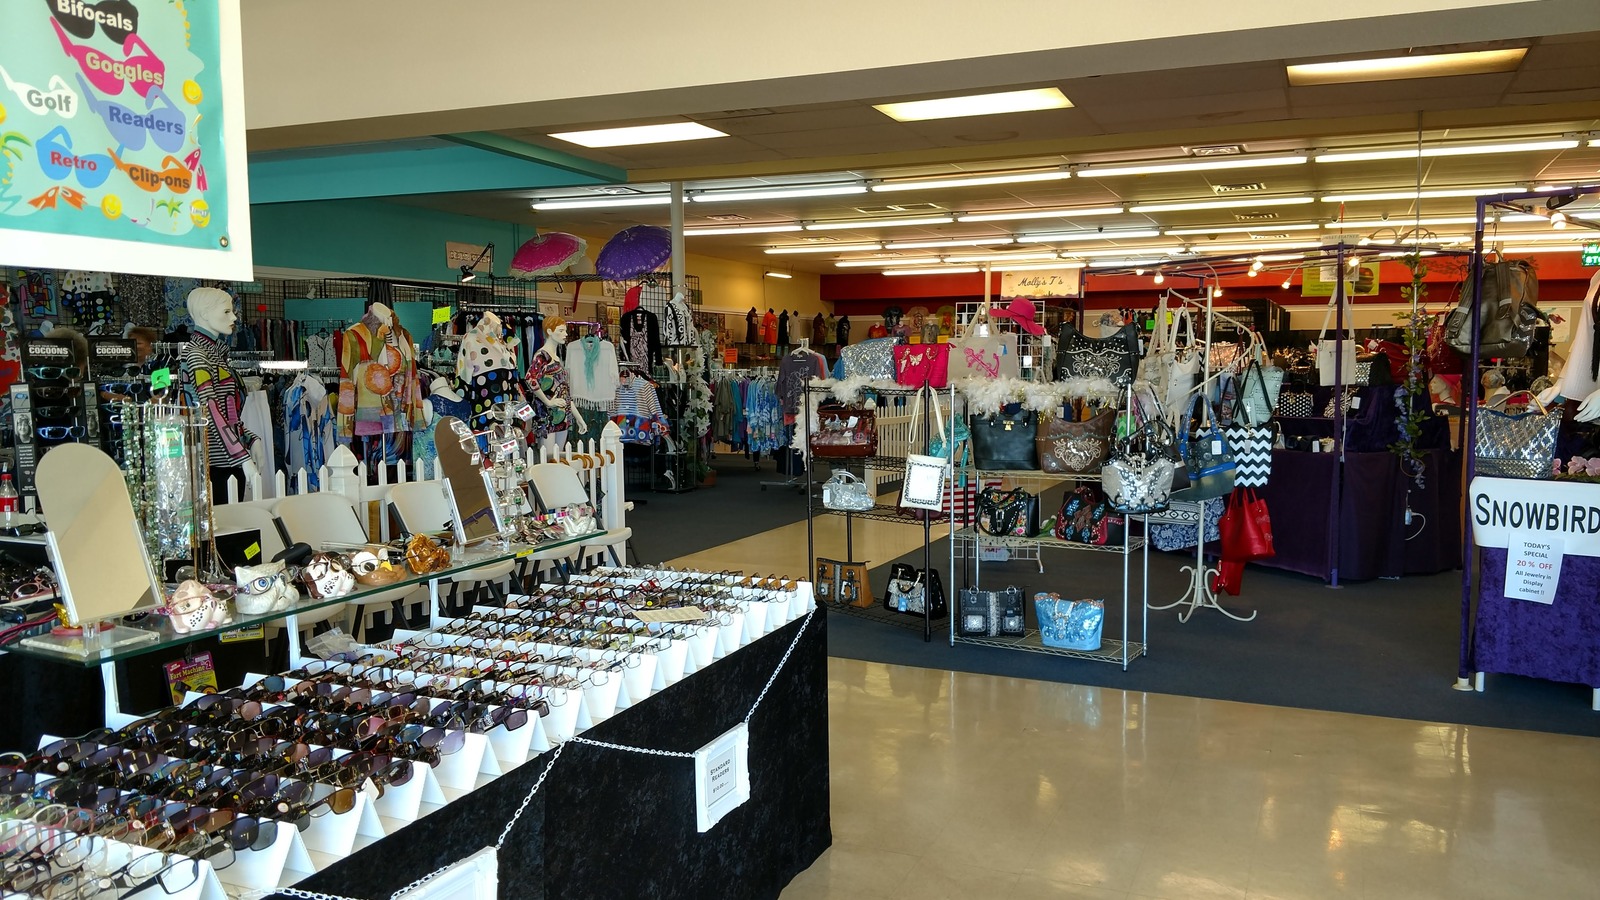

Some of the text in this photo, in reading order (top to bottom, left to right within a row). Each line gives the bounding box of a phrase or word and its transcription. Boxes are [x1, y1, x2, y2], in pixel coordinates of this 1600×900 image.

[57, 0, 133, 31] Bifocals
[85, 52, 163, 86] Goggles
[26, 89, 71, 112] Golf
[108, 105, 184, 135] Readers
[50, 151, 97, 171] Retro
[129, 166, 190, 189] Clip-ons
[1018, 276, 1047, 288] Molly's
[28, 347, 69, 355] COCOONS
[96, 347, 132, 355] COCOONS
[1475, 493, 1600, 534] SNOWBIRD
[1523, 541, 1551, 550] TODAY'S
[1523, 550, 1548, 559] SPECIAL
[1538, 562, 1553, 570] OFF
[1524, 571, 1545, 580] Jewelry
[1519, 587, 1539, 595] cabinet
[1523, 579, 1543, 588] Display
[170, 672, 182, 680] Fart
[182, 665, 206, 676] Machine
[205, 660, 211, 669] 2
[710, 759, 730, 775] STANDARD
[711, 767, 730, 782] READERS
